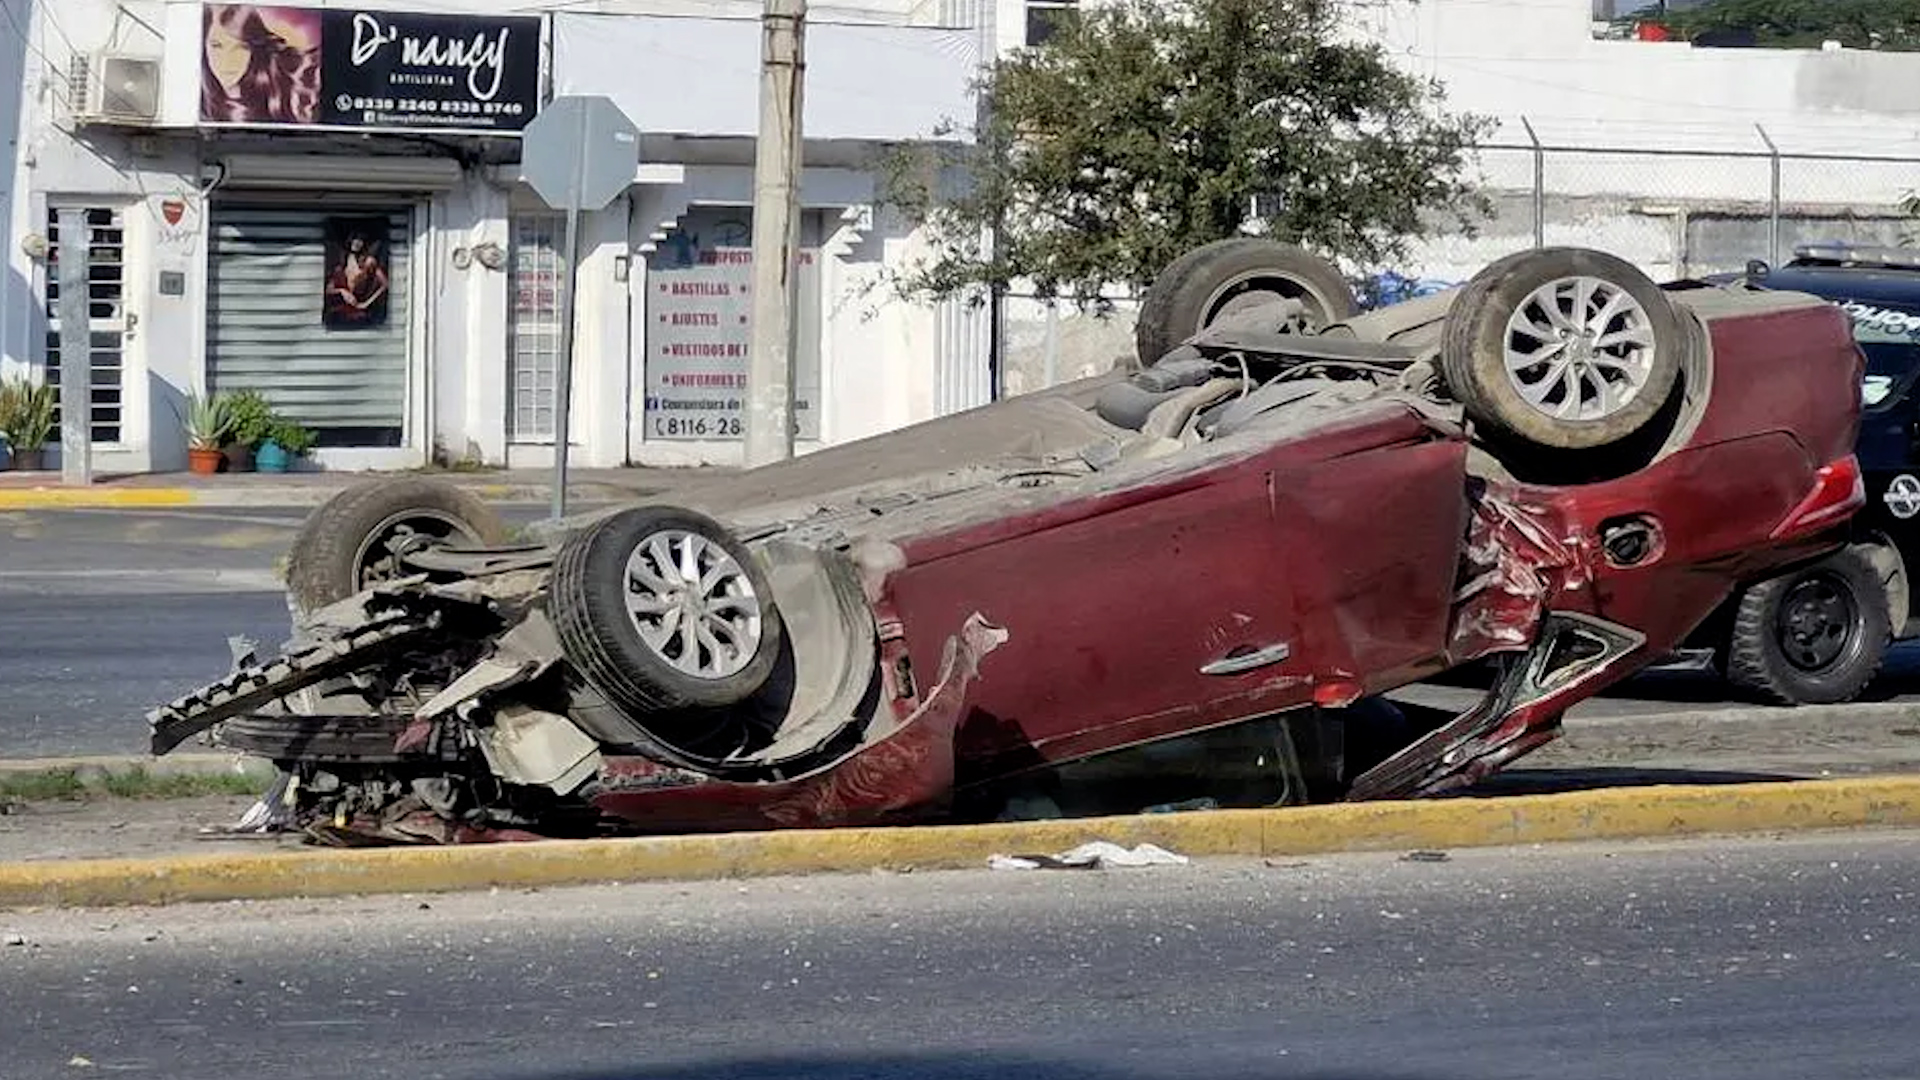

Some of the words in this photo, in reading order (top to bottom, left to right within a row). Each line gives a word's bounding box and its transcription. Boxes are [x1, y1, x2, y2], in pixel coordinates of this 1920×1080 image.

[672, 282, 730, 296] BASTILLAS
[672, 312, 719, 326] AJUSTES
[672, 344, 725, 357] VESTIDOS
[672, 374, 735, 387] UNIFORMES
